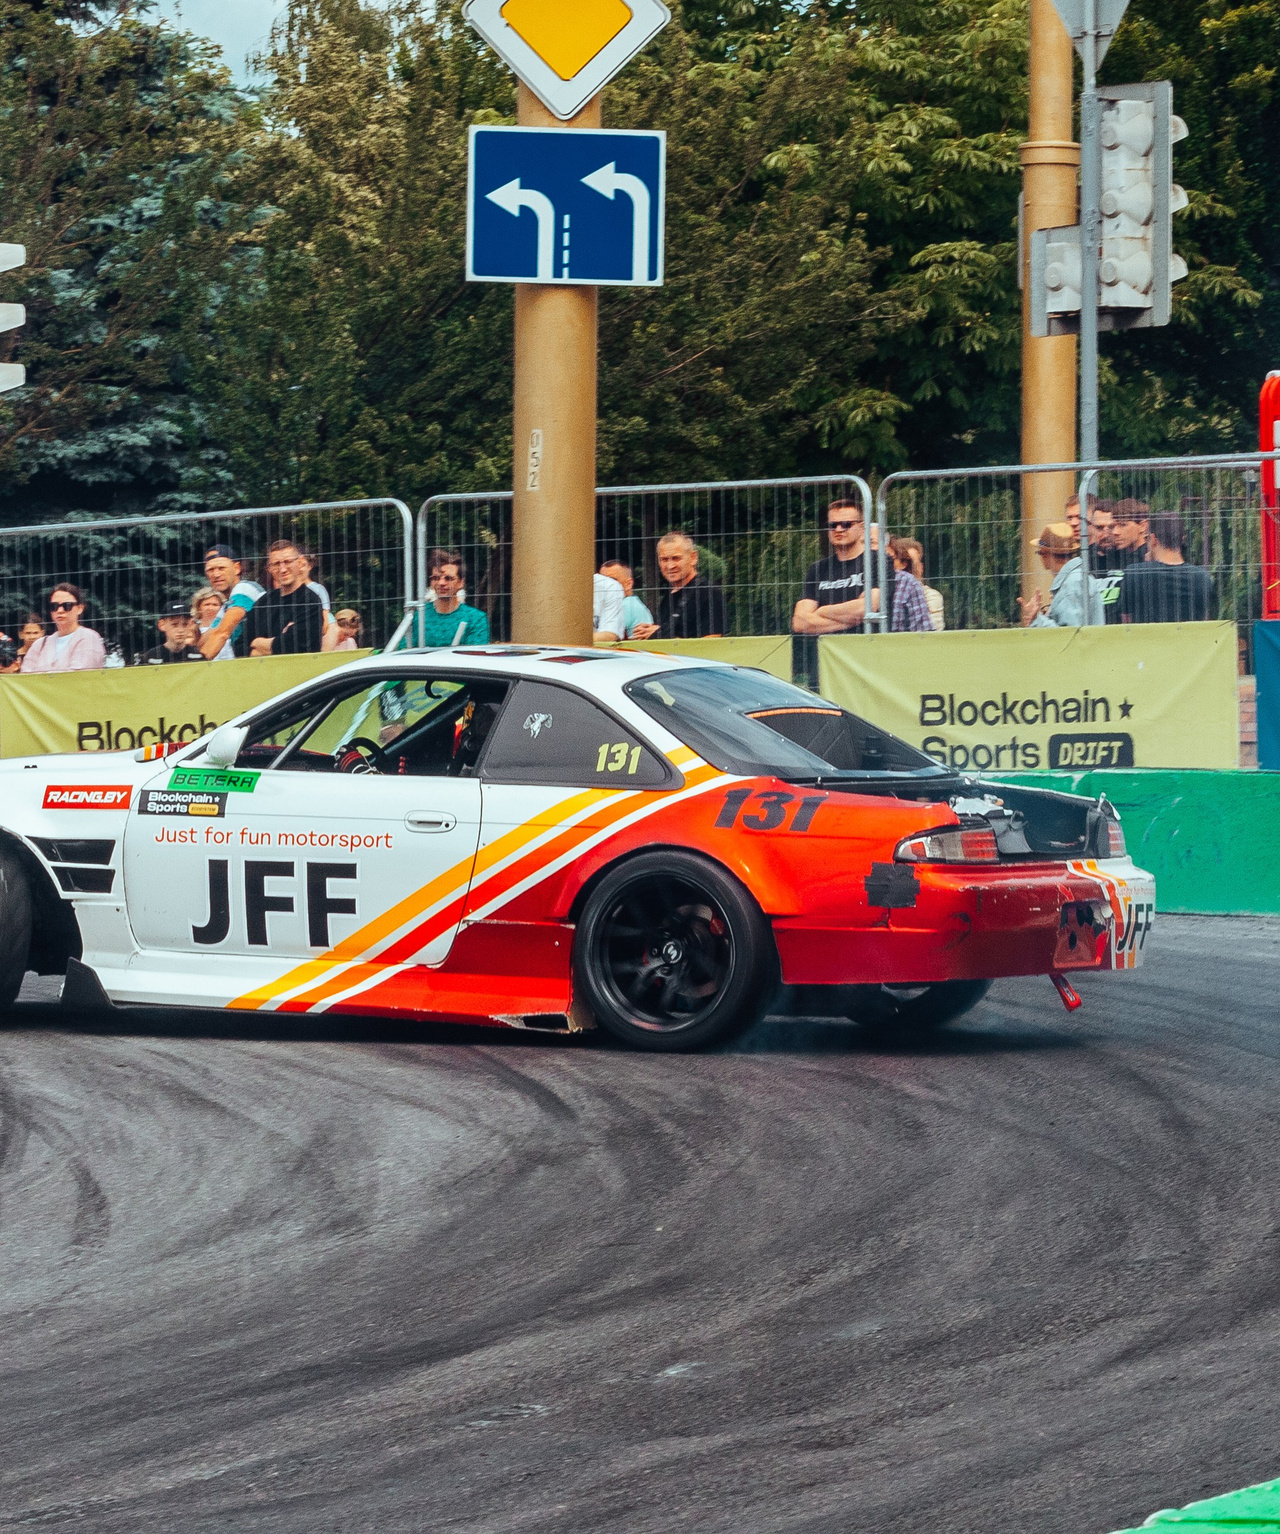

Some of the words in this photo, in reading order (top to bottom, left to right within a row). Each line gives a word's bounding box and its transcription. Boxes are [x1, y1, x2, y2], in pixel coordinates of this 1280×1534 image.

[529, 432, 540, 488] 052
[919, 690, 1111, 726] Blockchain
[76, 713, 232, 750] Blockch
[595, 742, 642, 775] 131
[921, 736, 1041, 769] Sports
[1057, 741, 1124, 766] DRIFT
[46, 791, 128, 804] RACING.BY
[146, 802, 188, 815] Sports
[148, 791, 213, 804] Blockchain
[714, 787, 830, 833] 131
[154, 826, 198, 844] Just
[204, 826, 234, 845] for
[239, 827, 271, 846] fun
[277, 829, 394, 853] motorsport
[191, 859, 358, 948] JFF
[1116, 903, 1154, 952] JFF
